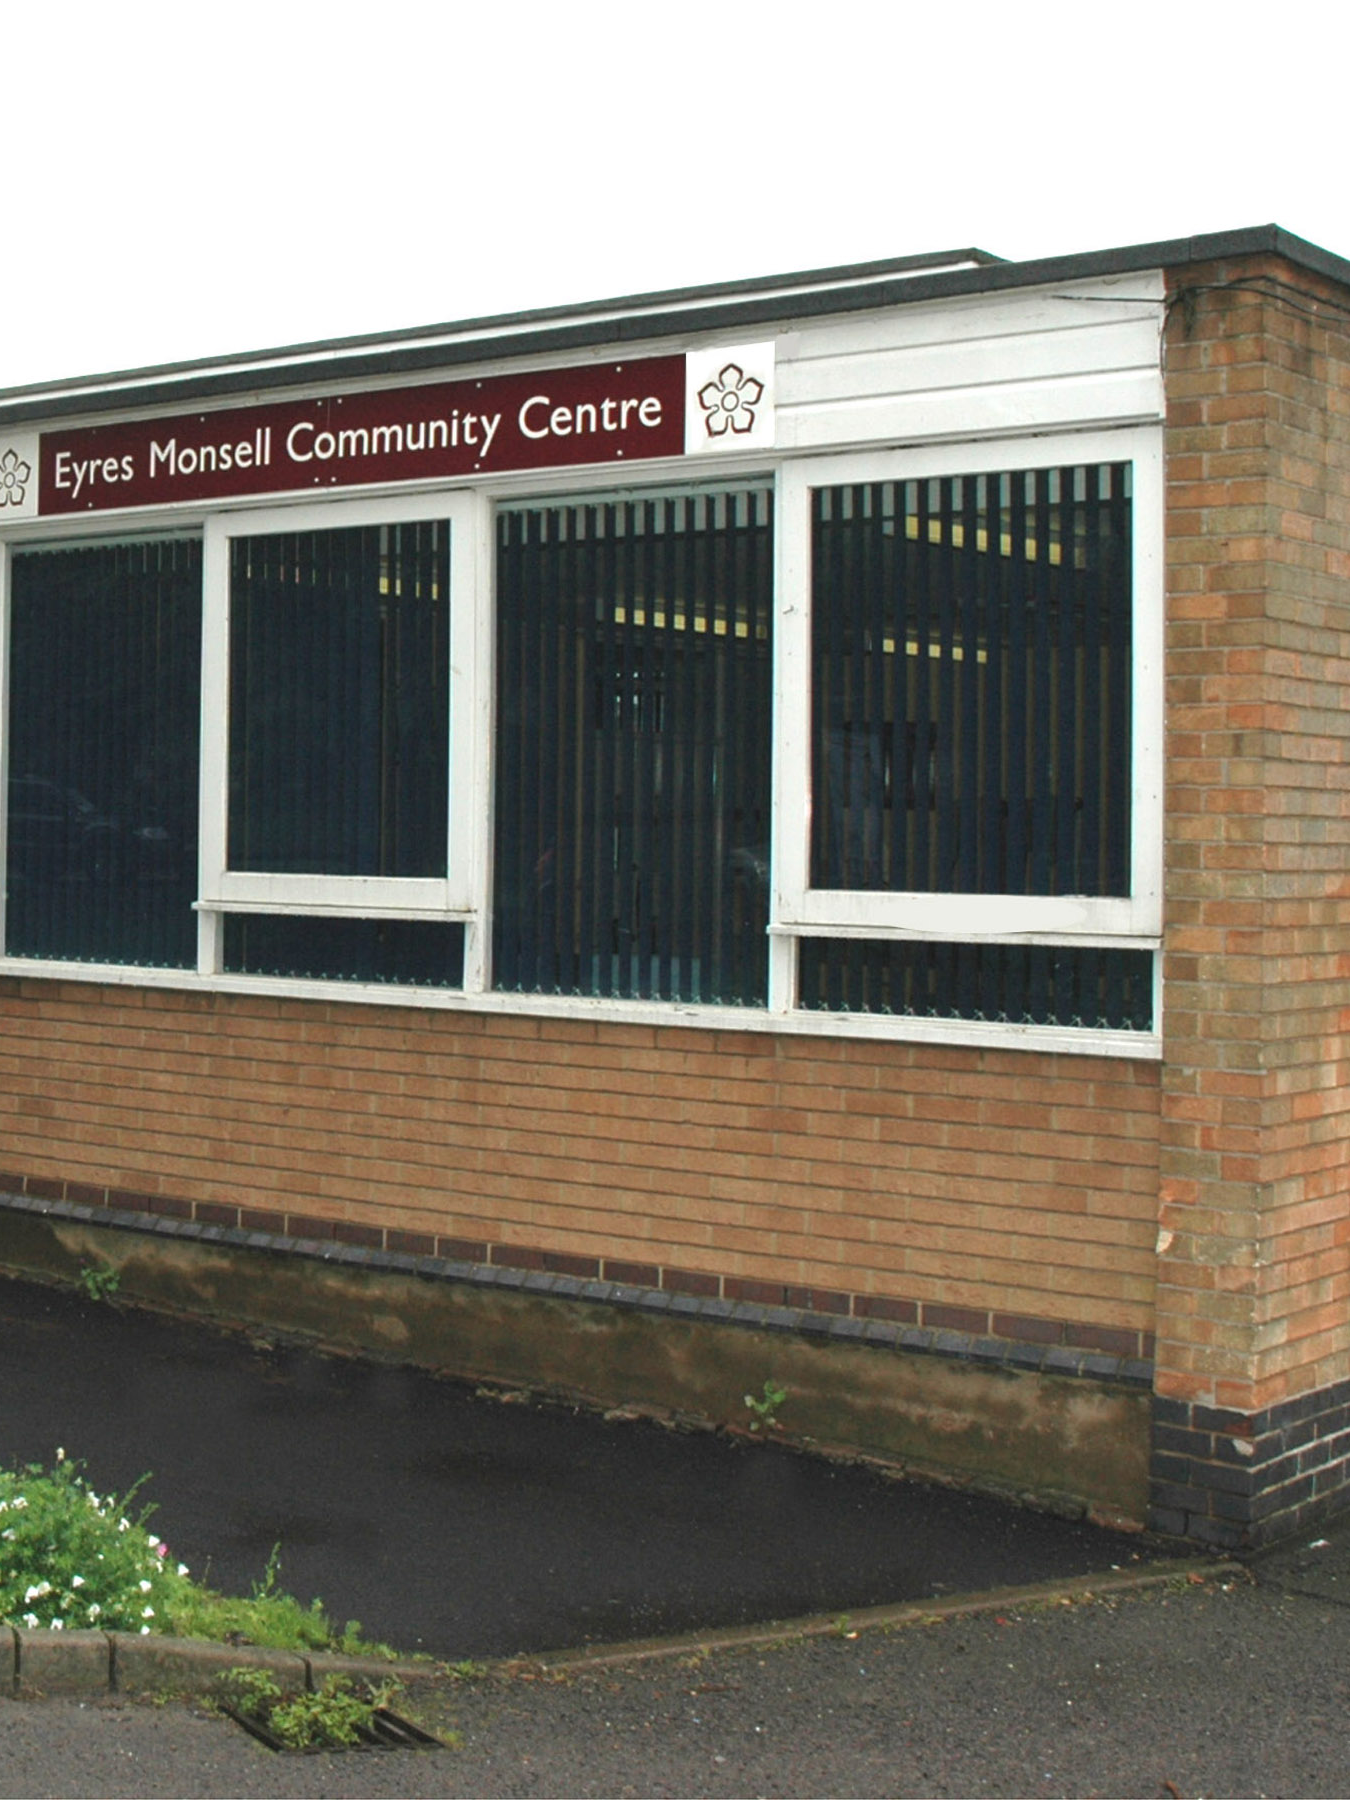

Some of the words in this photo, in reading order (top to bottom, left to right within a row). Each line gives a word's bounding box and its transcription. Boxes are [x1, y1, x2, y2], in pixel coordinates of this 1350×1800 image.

[54, 451, 134, 499] Eyres
[149, 426, 271, 478] Monsell
[286, 408, 502, 462] Community
[518, 395, 663, 439] Centre
